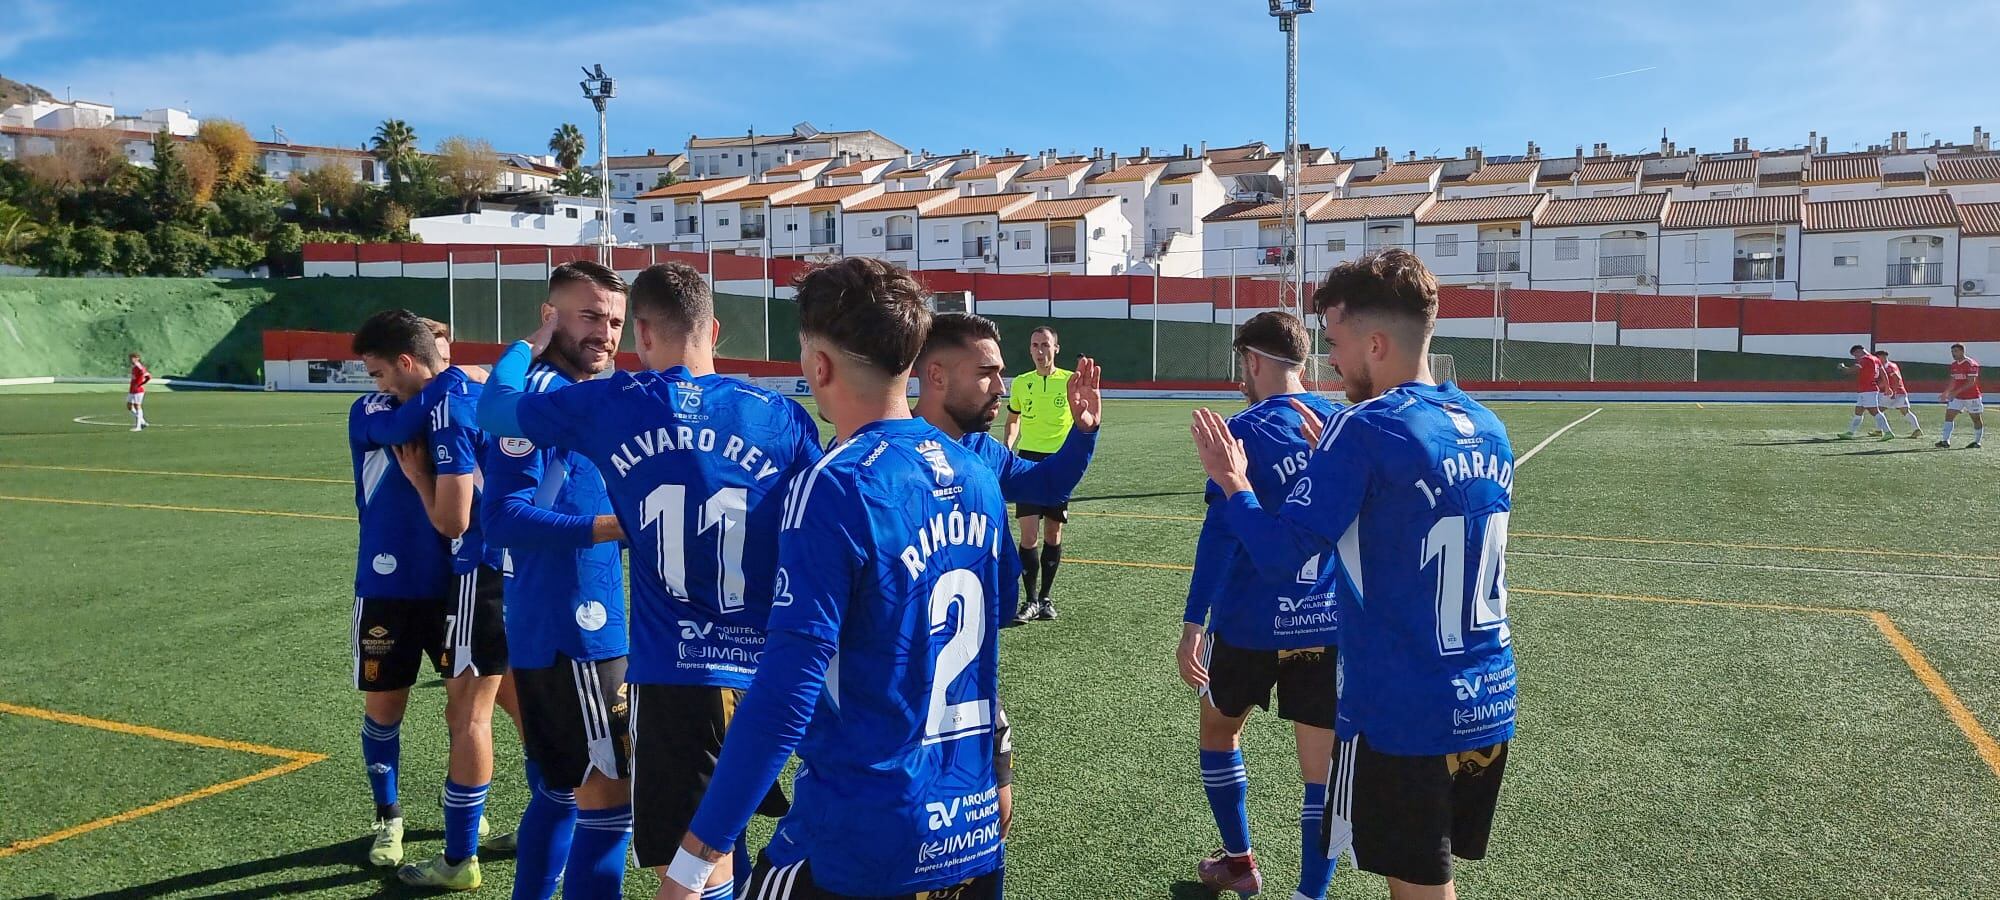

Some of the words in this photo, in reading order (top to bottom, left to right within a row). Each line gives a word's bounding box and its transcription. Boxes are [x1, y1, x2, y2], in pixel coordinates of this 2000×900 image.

[678, 391, 703, 410] 75
[610, 426, 715, 478] ALVARO
[722, 434, 778, 481] REY
[1415, 479, 1442, 509] J.
[640, 484, 747, 614] 11
[901, 504, 987, 581] RAMÓN
[1420, 512, 1510, 657] 14
[676, 661, 704, 670] Empresa
[922, 569, 991, 746] 2
[914, 862, 943, 874] Empresa
